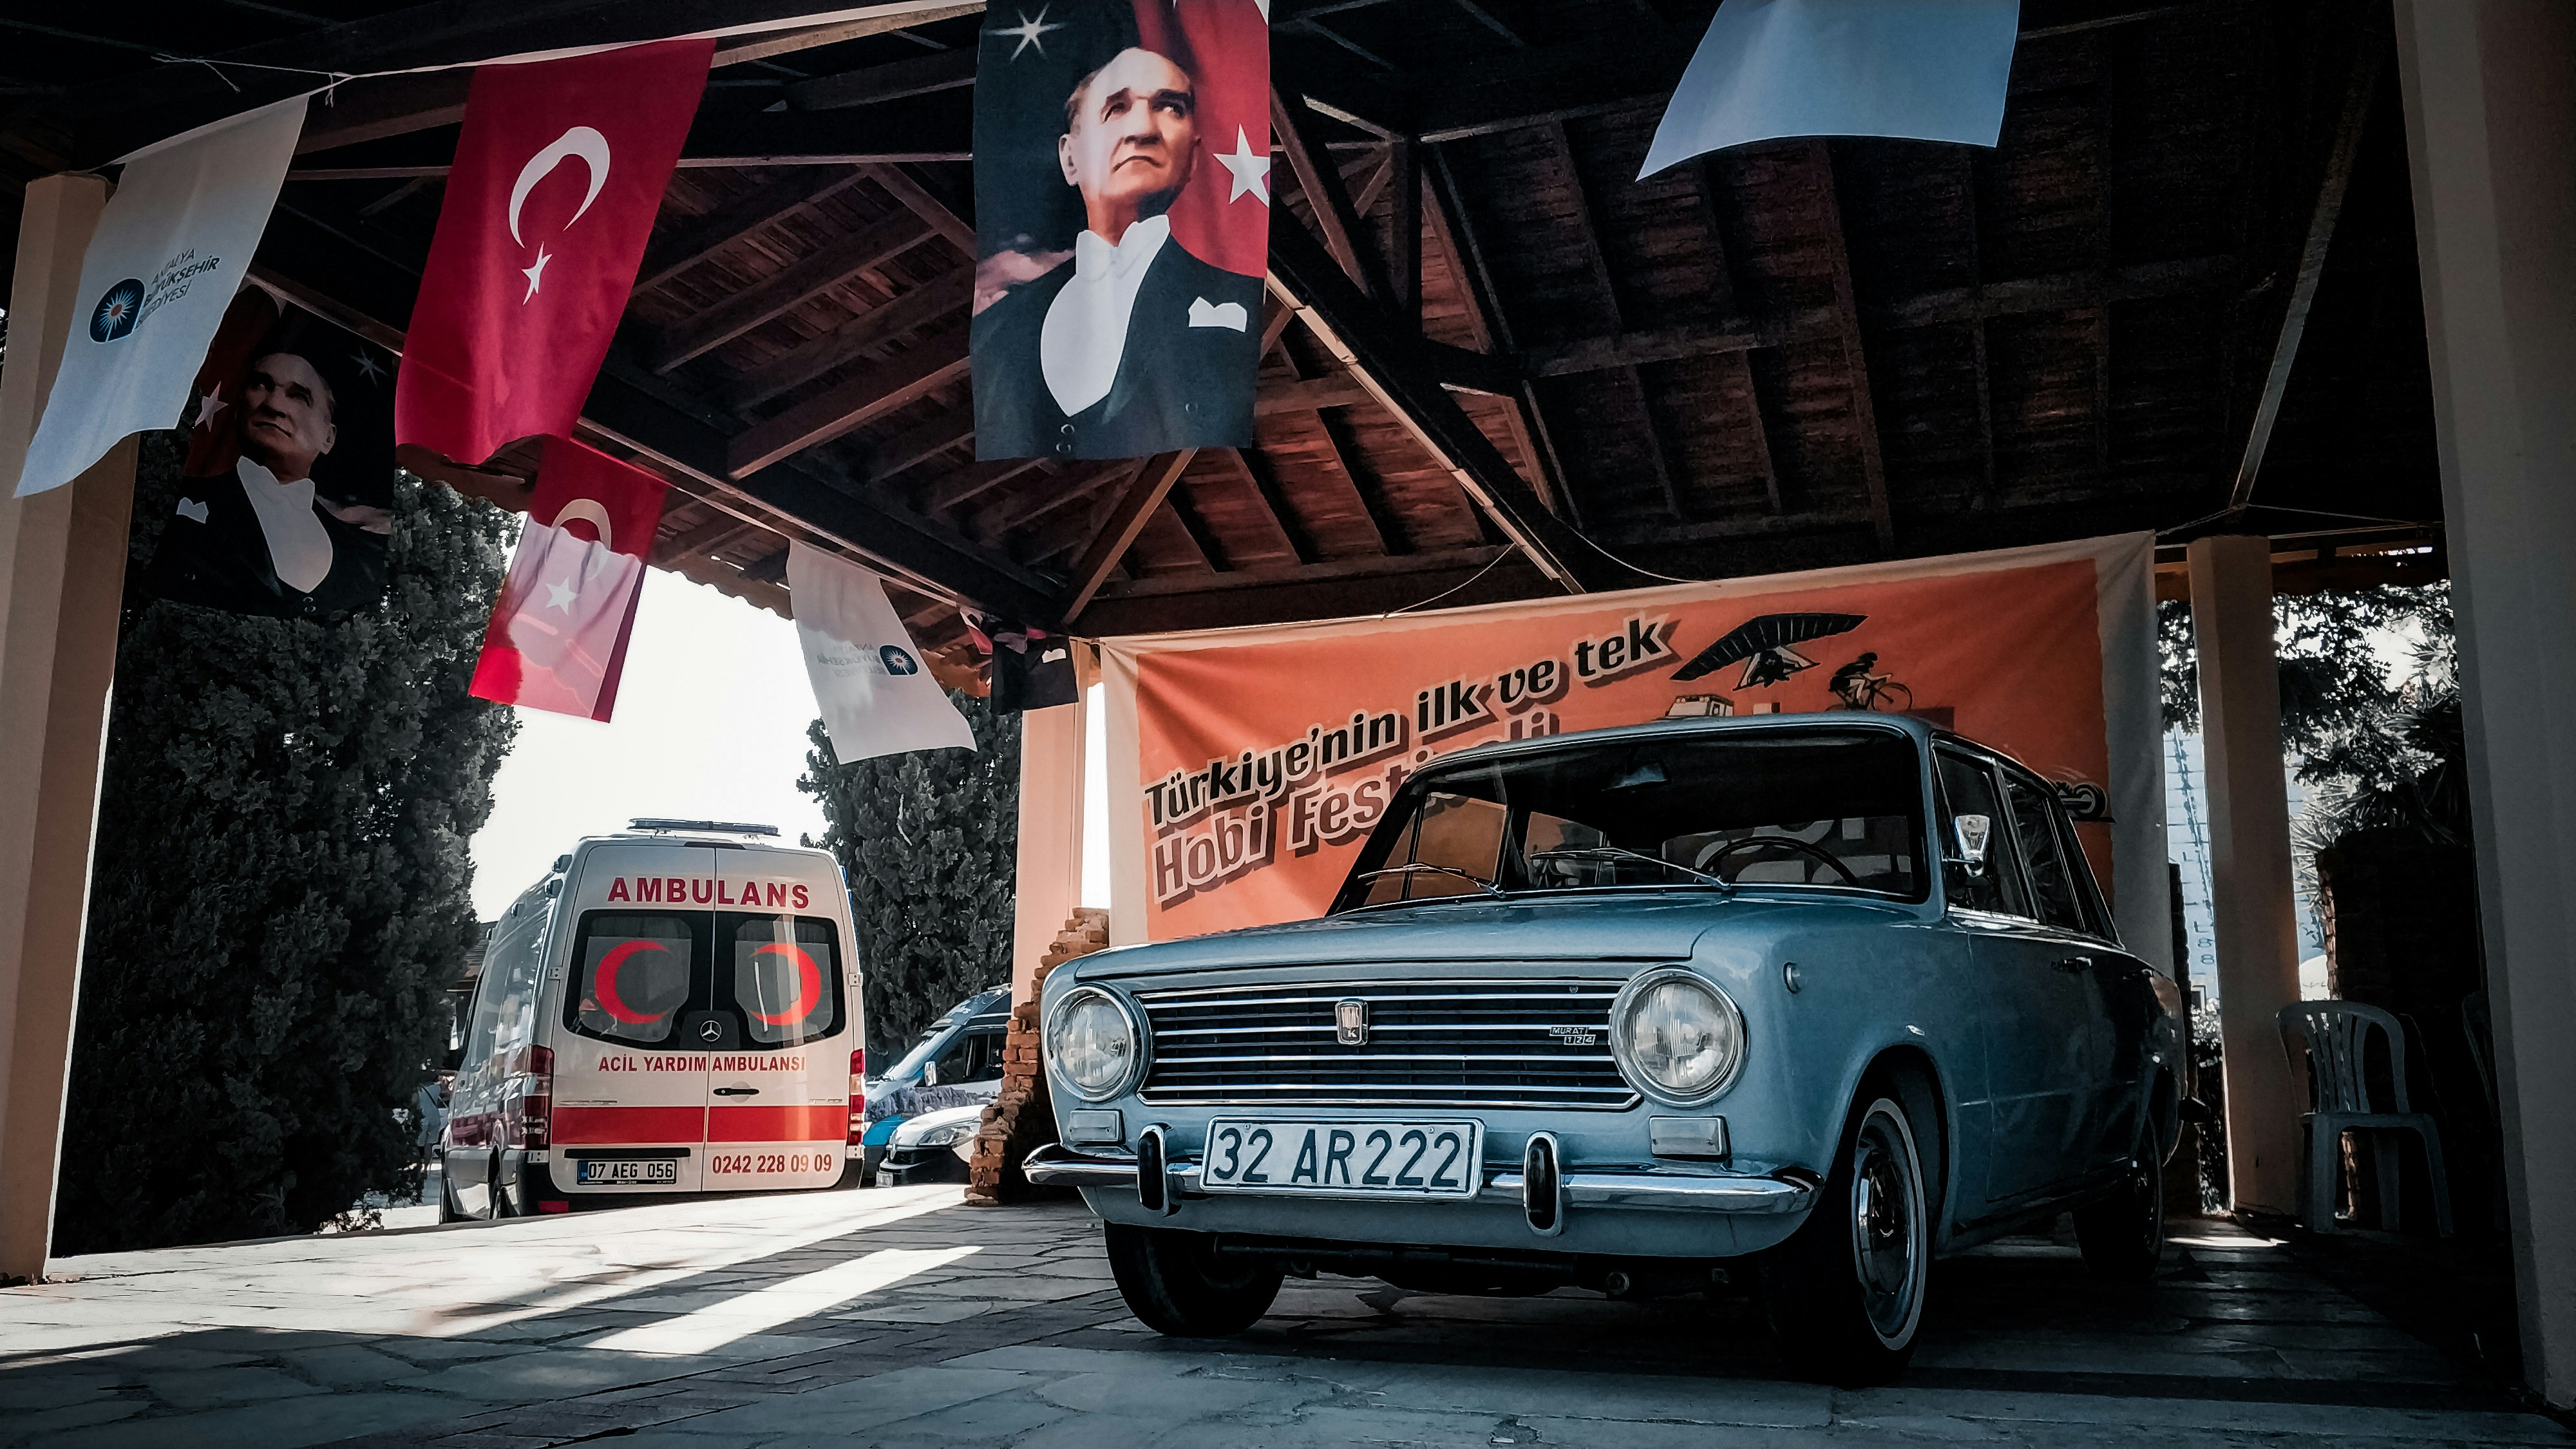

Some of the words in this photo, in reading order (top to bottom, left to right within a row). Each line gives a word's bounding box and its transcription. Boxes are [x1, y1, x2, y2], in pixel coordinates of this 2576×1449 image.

[1143, 710, 1397, 829] Türkiye'nin
[1417, 679, 1483, 734] ilk
[1497, 658, 1555, 705] ve
[1574, 616, 1663, 679] tek
[1153, 802, 1271, 900] Hobi
[607, 876, 810, 909] AMBULANS
[598, 1054, 638, 1072] ACİL
[643, 1056, 707, 1072] YARDIM
[712, 1056, 805, 1072] AMBULANSI
[589, 1163, 606, 1179] 07
[611, 1163, 638, 1179] AEG
[647, 1163, 674, 1178] 056
[712, 1155, 752, 1174] 0242
[756, 1155, 786, 1173] 228
[790, 1154, 810, 1173] 09
[814, 1153, 832, 1172] 09
[1213, 1127, 1273, 1182] 32
[1291, 1128, 1461, 1187] AR222
